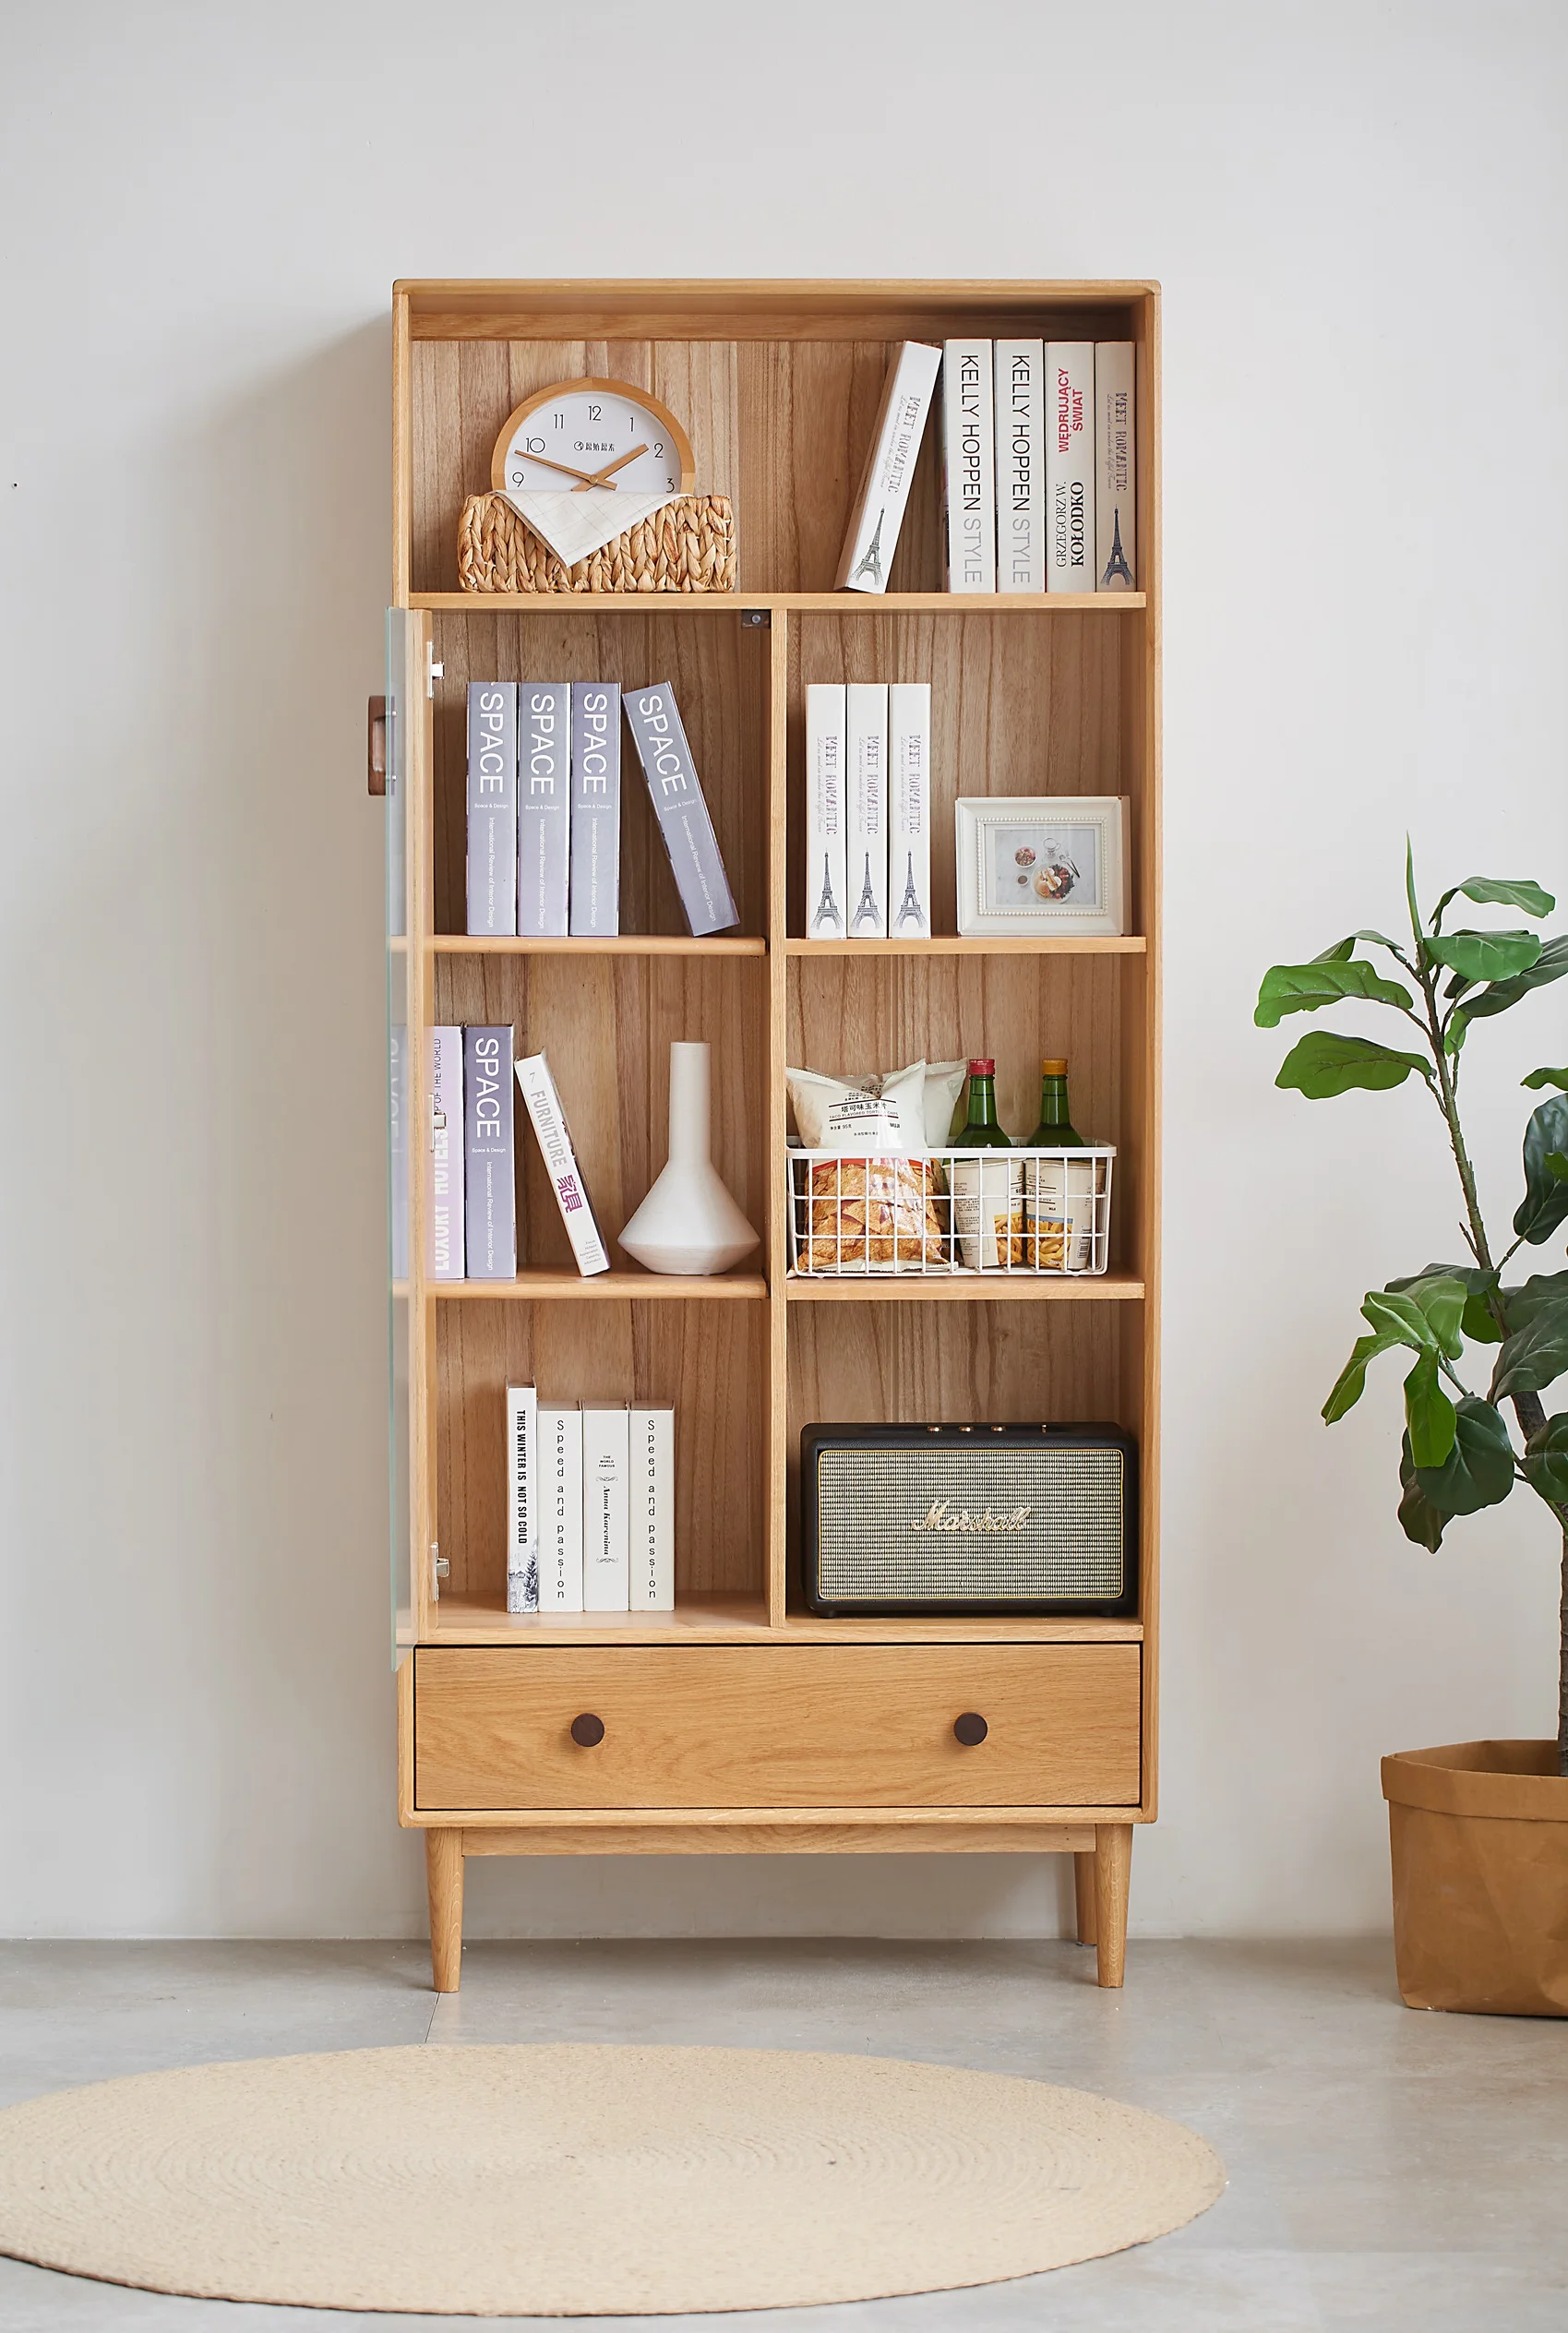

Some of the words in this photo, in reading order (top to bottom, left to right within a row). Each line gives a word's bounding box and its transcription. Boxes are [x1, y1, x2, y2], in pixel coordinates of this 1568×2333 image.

[961, 355, 980, 418] KELLY
[1012, 355, 1030, 418] KELLY
[554, 414, 564, 429] 11
[588, 406, 601, 421] 12
[630, 417, 634, 432] 1
[903, 395, 921, 430] MEET
[1058, 368, 1071, 453] WĘDRUJĄCY
[1070, 389, 1083, 431] ŚWIAT
[1115, 393, 1127, 425] MEET
[525, 437, 546, 454] 10
[653, 443, 664, 458] 2
[887, 433, 911, 493] ROMANTIC
[1115, 431, 1126, 491] ROMANTIC
[512, 472, 525, 487] 9
[962, 424, 981, 510] HOPPEN
[1012, 424, 1030, 511] HOPPEN
[666, 478, 675, 493] 3
[1055, 481, 1066, 498] W.
[1055, 499, 1066, 568] GRZEGORZ
[1071, 481, 1084, 567] KOŁODKO
[964, 518, 982, 583] STYLE
[1012, 518, 1030, 584] STYLE
[479, 693, 504, 794] SPACE
[530, 694, 555, 795] SPACE
[583, 693, 608, 794] SPACE
[639, 695, 687, 796] SPACE
[826, 736, 838, 768] MEET
[867, 736, 879, 768] MEET
[909, 735, 921, 767] MEET
[826, 775, 837, 834] ROMANTIC
[867, 774, 878, 834] ROMANTIC
[909, 773, 920, 833] ROMANTIC
[682, 815, 696, 850] International
[692, 850, 702, 873] Review
[701, 879, 712, 902] Interior
[706, 900, 716, 921] Design
[475, 1037, 500, 1138] SPACE
[529, 1071, 535, 1083] 7
[841, 1101, 886, 1113] 塔可味玉米片
[530, 1090, 567, 1167] FURNITURE
[557, 1174, 583, 1213] 家具
[516, 1410, 526, 1431] THIS
[517, 1434, 527, 1469] WINTER
[517, 1472, 527, 1481] IS
[517, 1486, 527, 1504] NOT
[518, 1506, 527, 1519] SO
[518, 1521, 527, 1544] COLD
[911, 1499, 1031, 1531] Marshall
